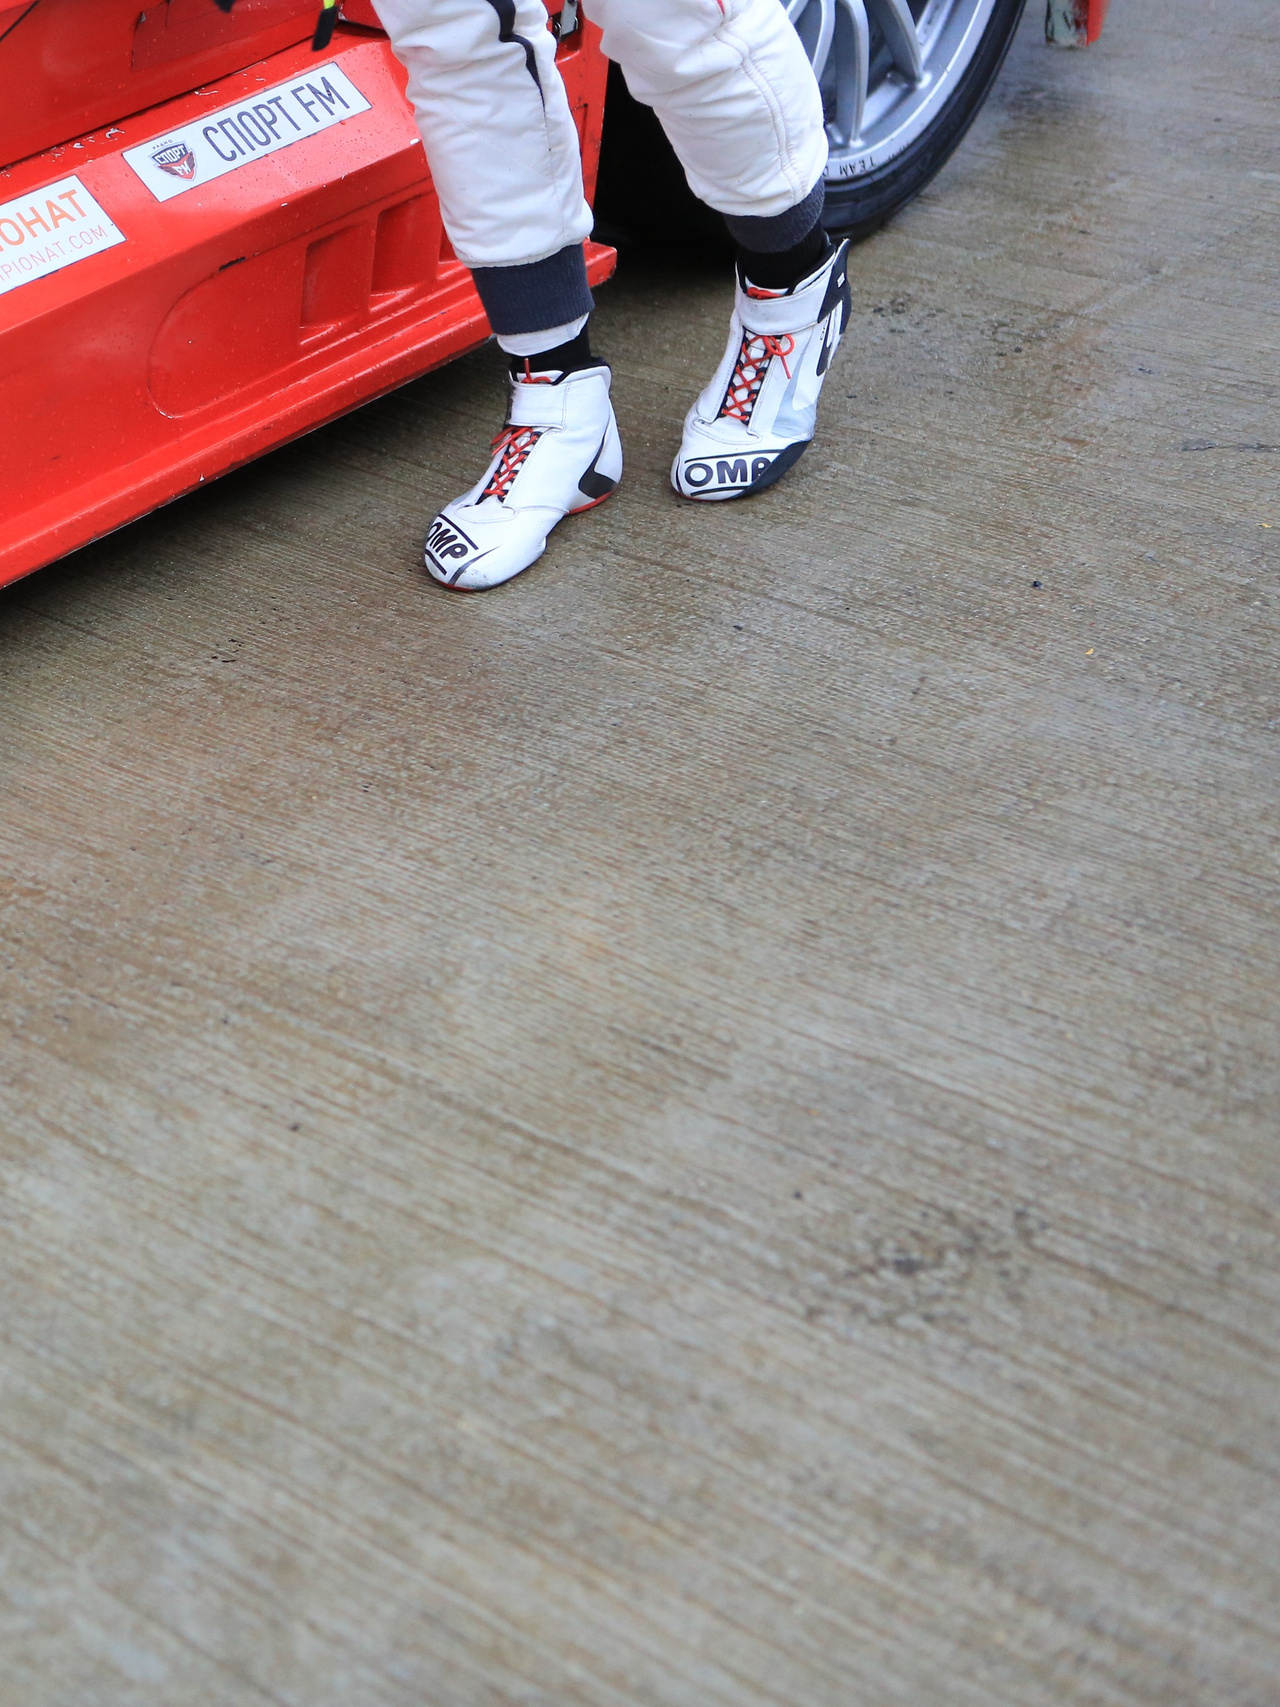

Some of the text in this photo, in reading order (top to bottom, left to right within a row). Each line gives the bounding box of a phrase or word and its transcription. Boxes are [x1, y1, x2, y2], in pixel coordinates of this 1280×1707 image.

[202, 76, 351, 162] СПОРТ FM
[153, 145, 186, 165] СПОРТ
[172, 160, 191, 176] FM
